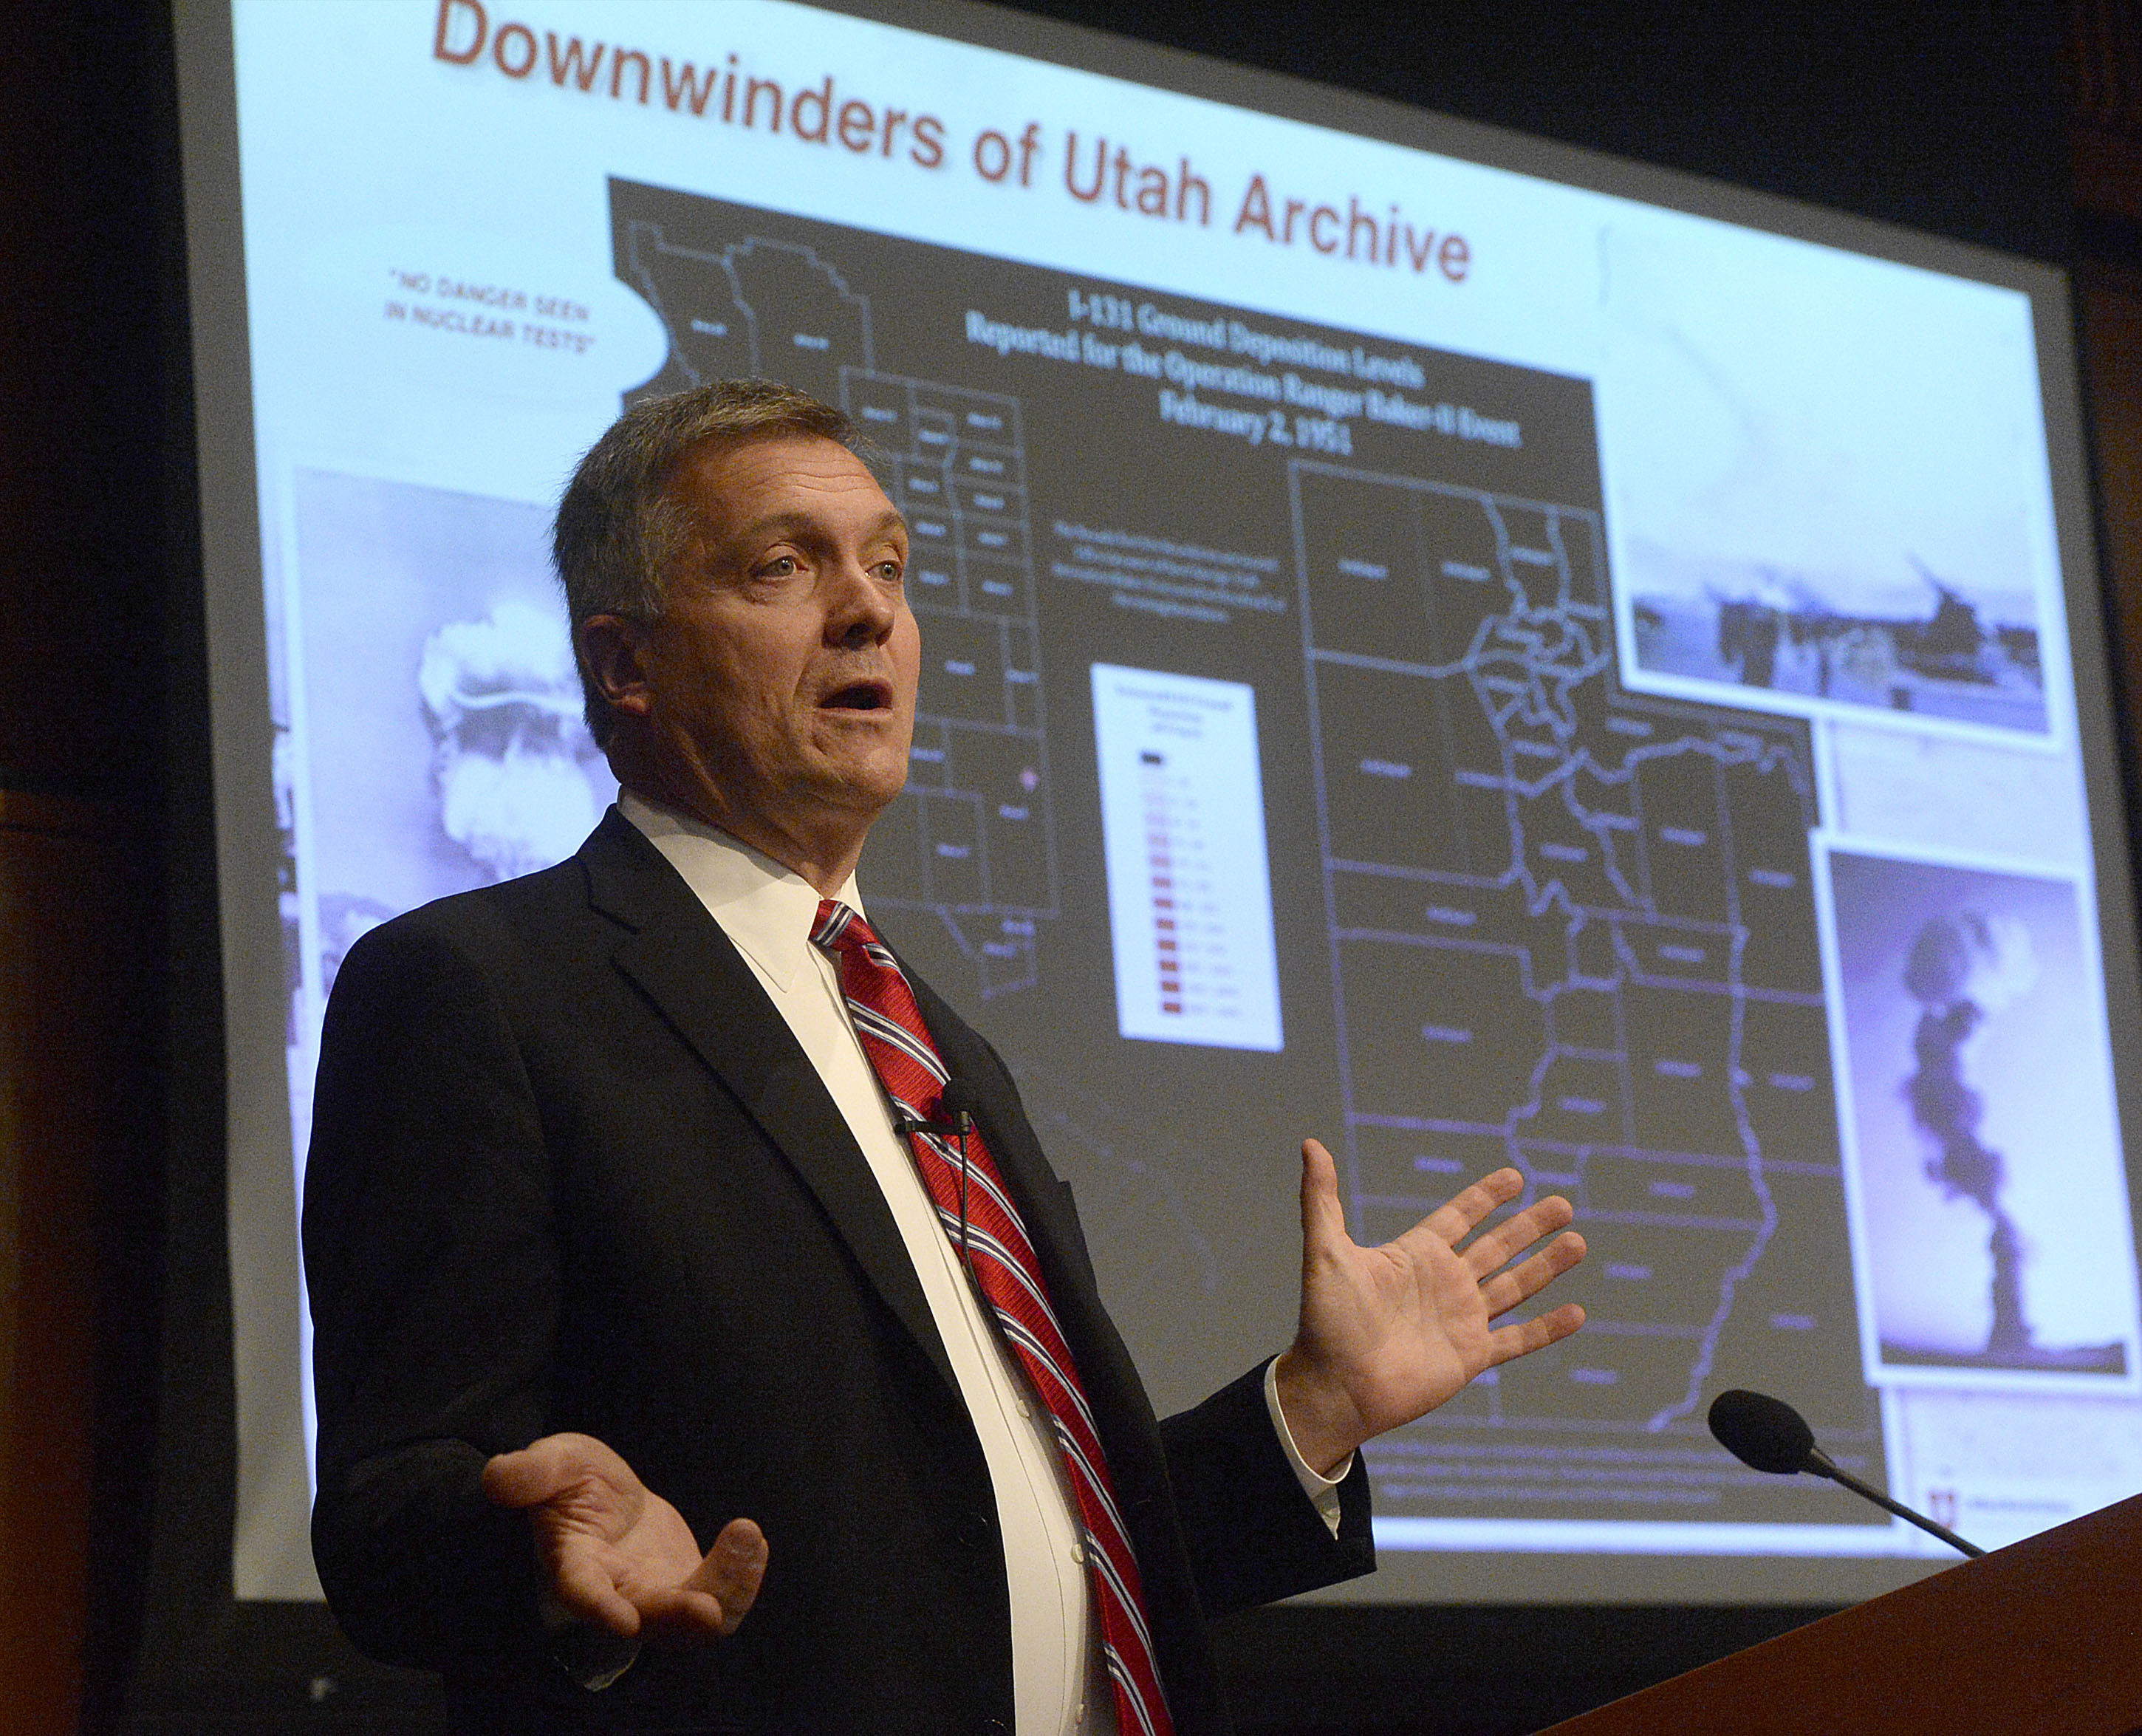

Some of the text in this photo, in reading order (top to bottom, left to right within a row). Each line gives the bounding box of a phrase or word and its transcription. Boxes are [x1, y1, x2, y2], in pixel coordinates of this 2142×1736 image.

[434, 0, 1470, 283] Downwinders of Utah Archive
[384, 298, 407, 320] IN
[411, 304, 516, 338] NUCLEAR
[437, 275, 527, 310] DANGER
[534, 294, 589, 322] SEEN
[1068, 288, 1427, 391] I-131 Ground Deposition Levels
[965, 309, 1081, 363] Reported
[1082, 332, 1119, 369] for
[1121, 341, 1163, 380] the
[1164, 350, 1282, 403] Operation
[1283, 372, 1363, 420] Ranger
[1157, 389, 1352, 456] February 2, 1951
